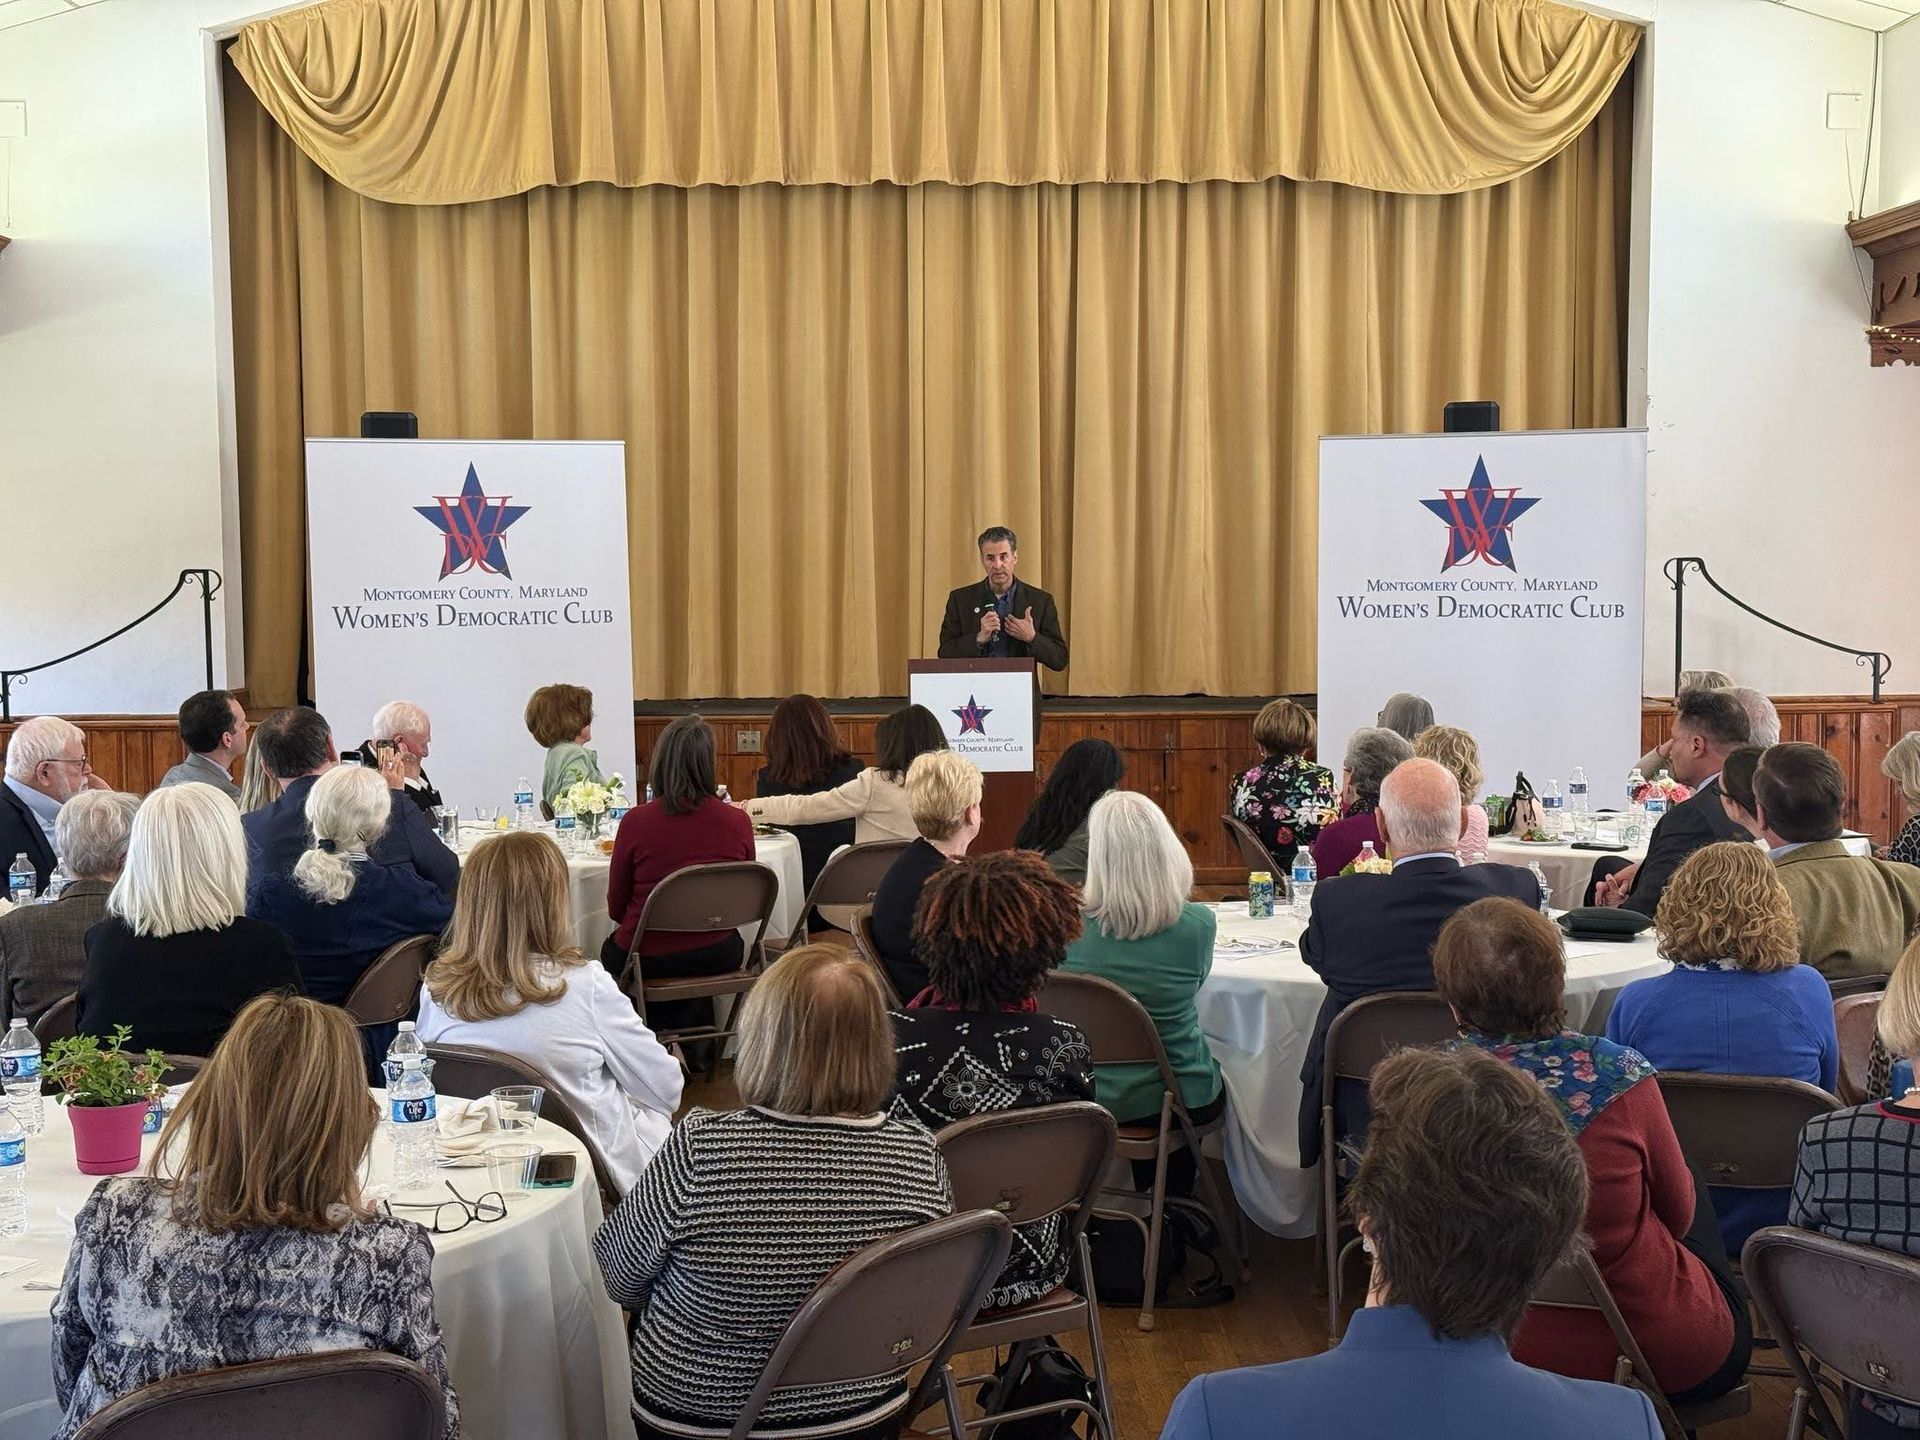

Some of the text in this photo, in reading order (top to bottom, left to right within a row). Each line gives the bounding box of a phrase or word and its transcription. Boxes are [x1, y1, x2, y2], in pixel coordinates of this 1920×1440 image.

[1367, 579, 1598, 592] MONTGOMERY COUNTY, MARYLAND
[363, 586, 588, 601] MONTGOMERY COUNTY, MARYLAND
[1337, 595, 1625, 619] WOMEN'S DEMOCRATIC CLUB
[332, 602, 613, 629] WOMEN'S DEMOCRATIC CLUB
[958, 744, 1002, 752] DEMOCRATIC
[1004, 743, 1023, 752] CLUB
